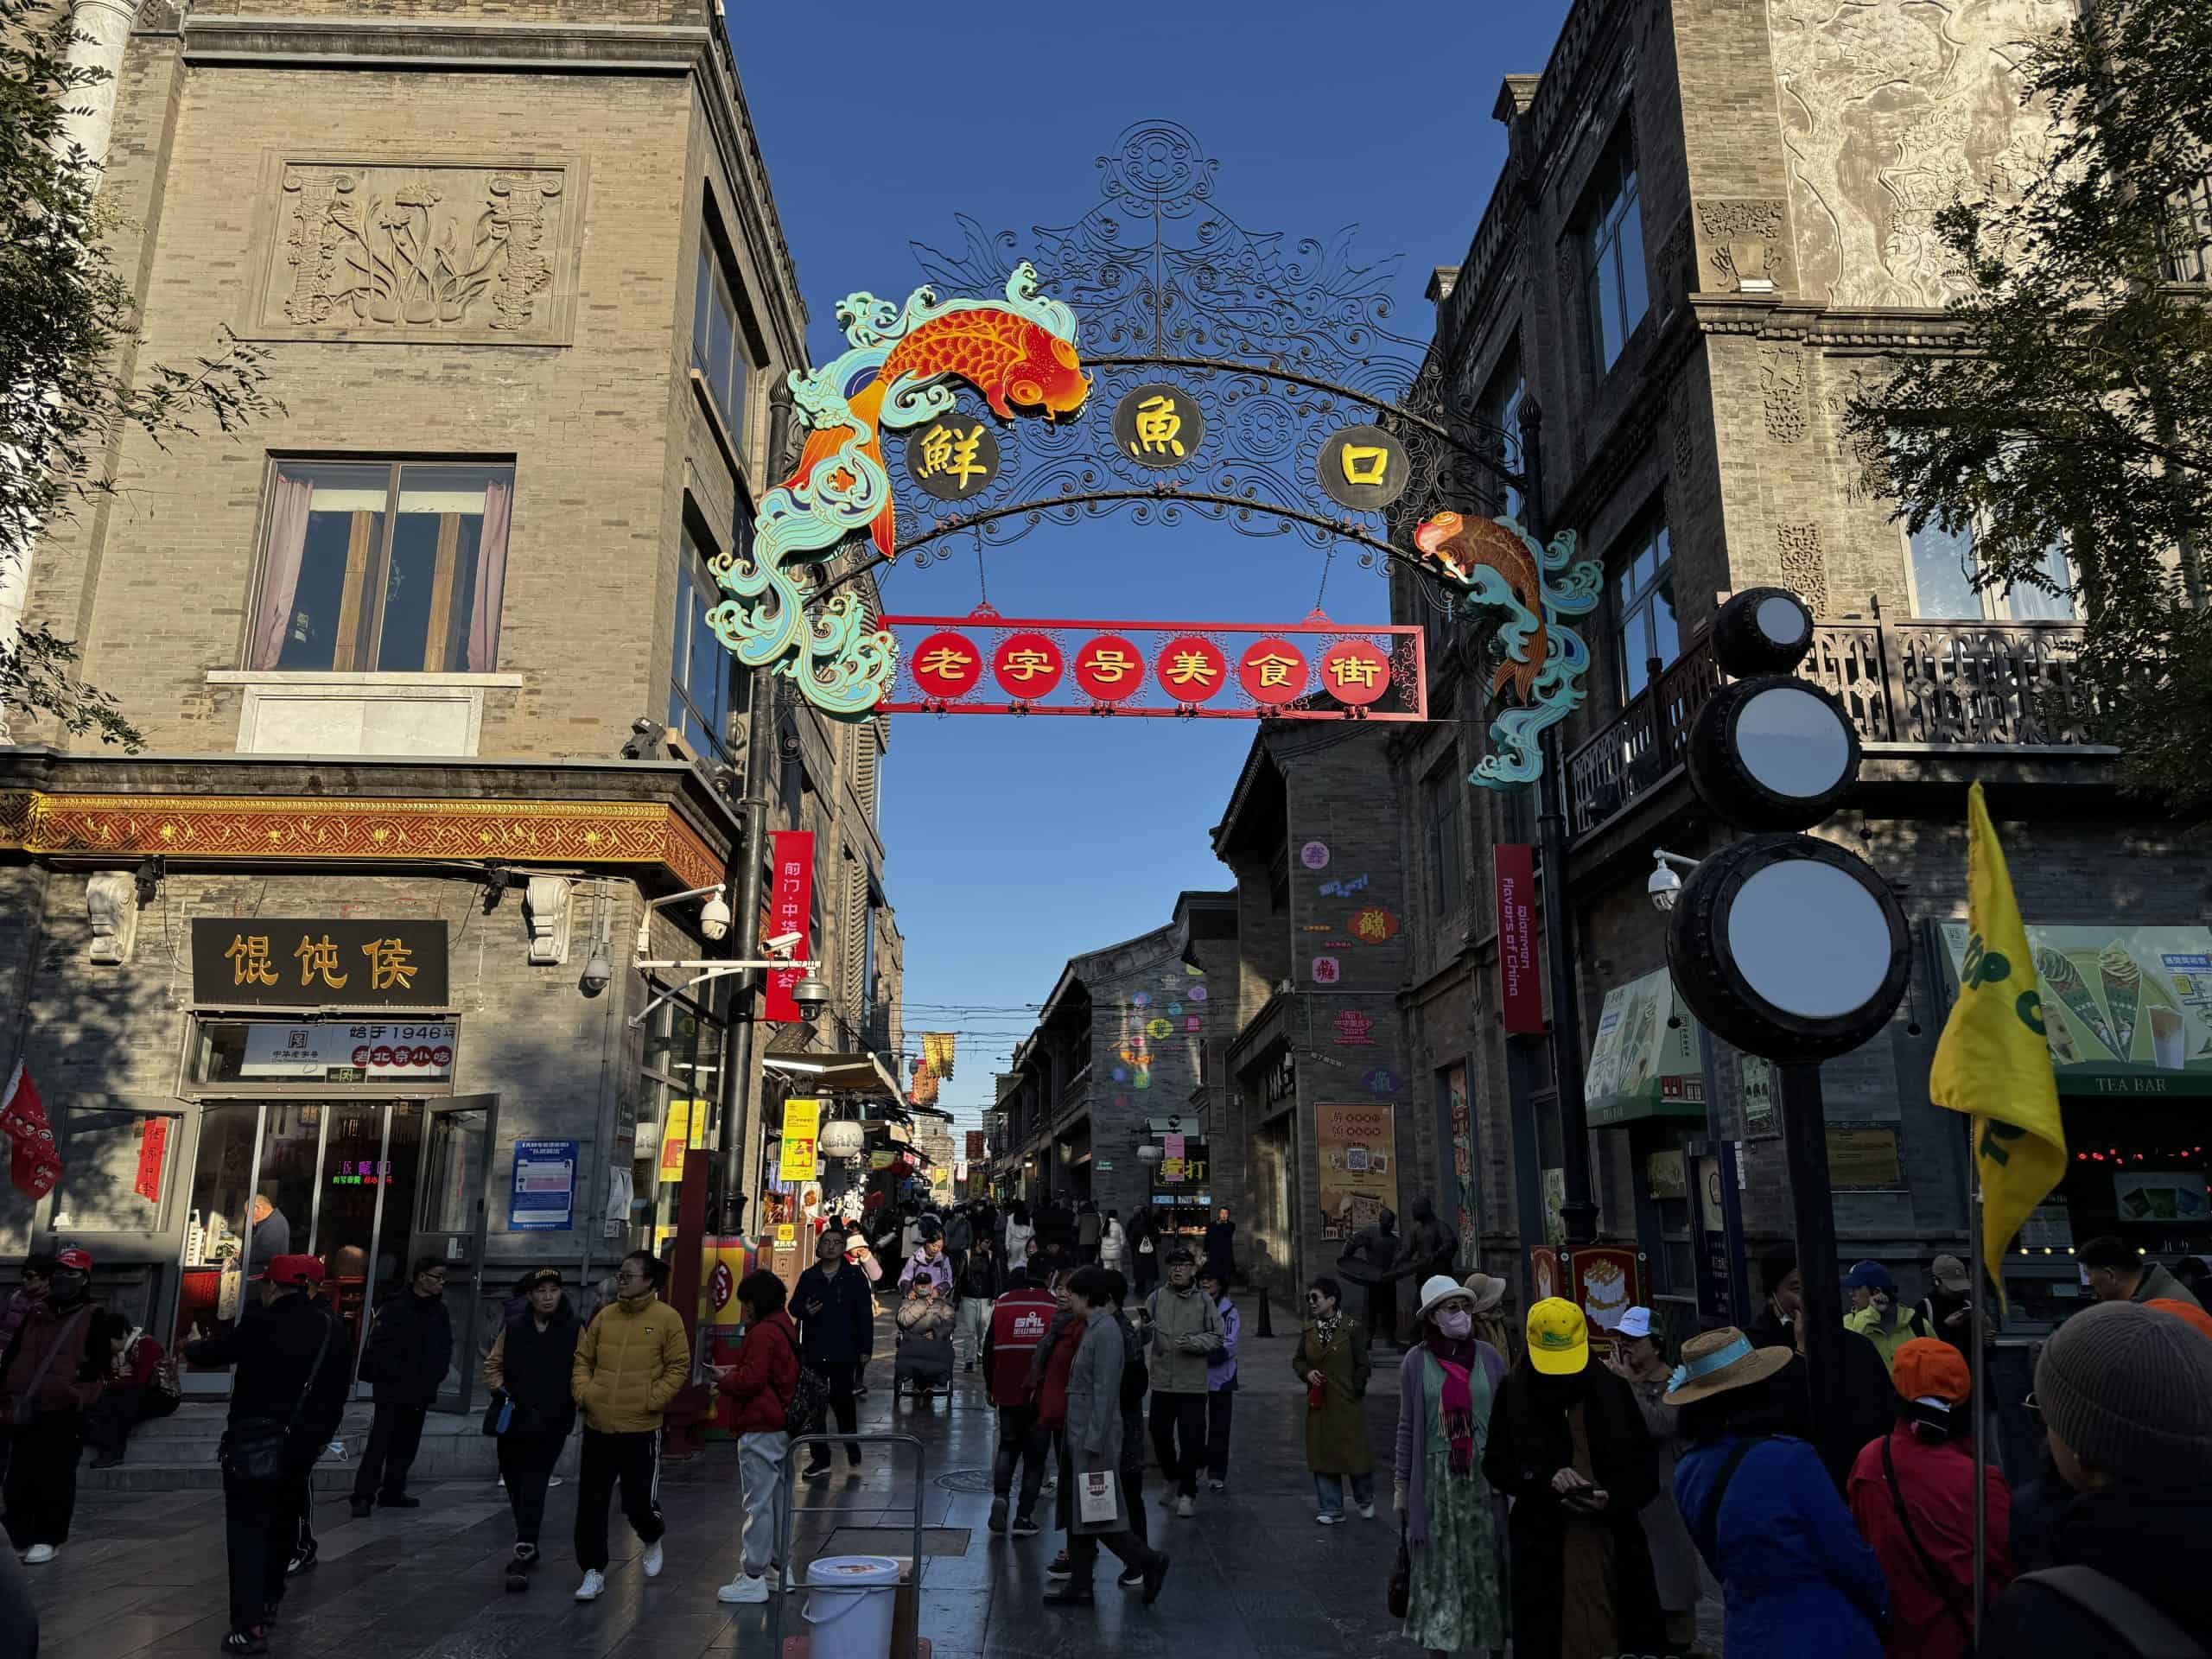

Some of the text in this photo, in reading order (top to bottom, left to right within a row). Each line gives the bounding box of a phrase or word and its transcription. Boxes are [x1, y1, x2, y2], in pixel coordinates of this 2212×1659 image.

[919, 645, 1382, 689] 老字号美食街
[225, 933, 419, 990] 馄饨侯
[354, 1049, 451, 1065] 老北京小吃
[2095, 1077, 2167, 1092] TEA BAR
